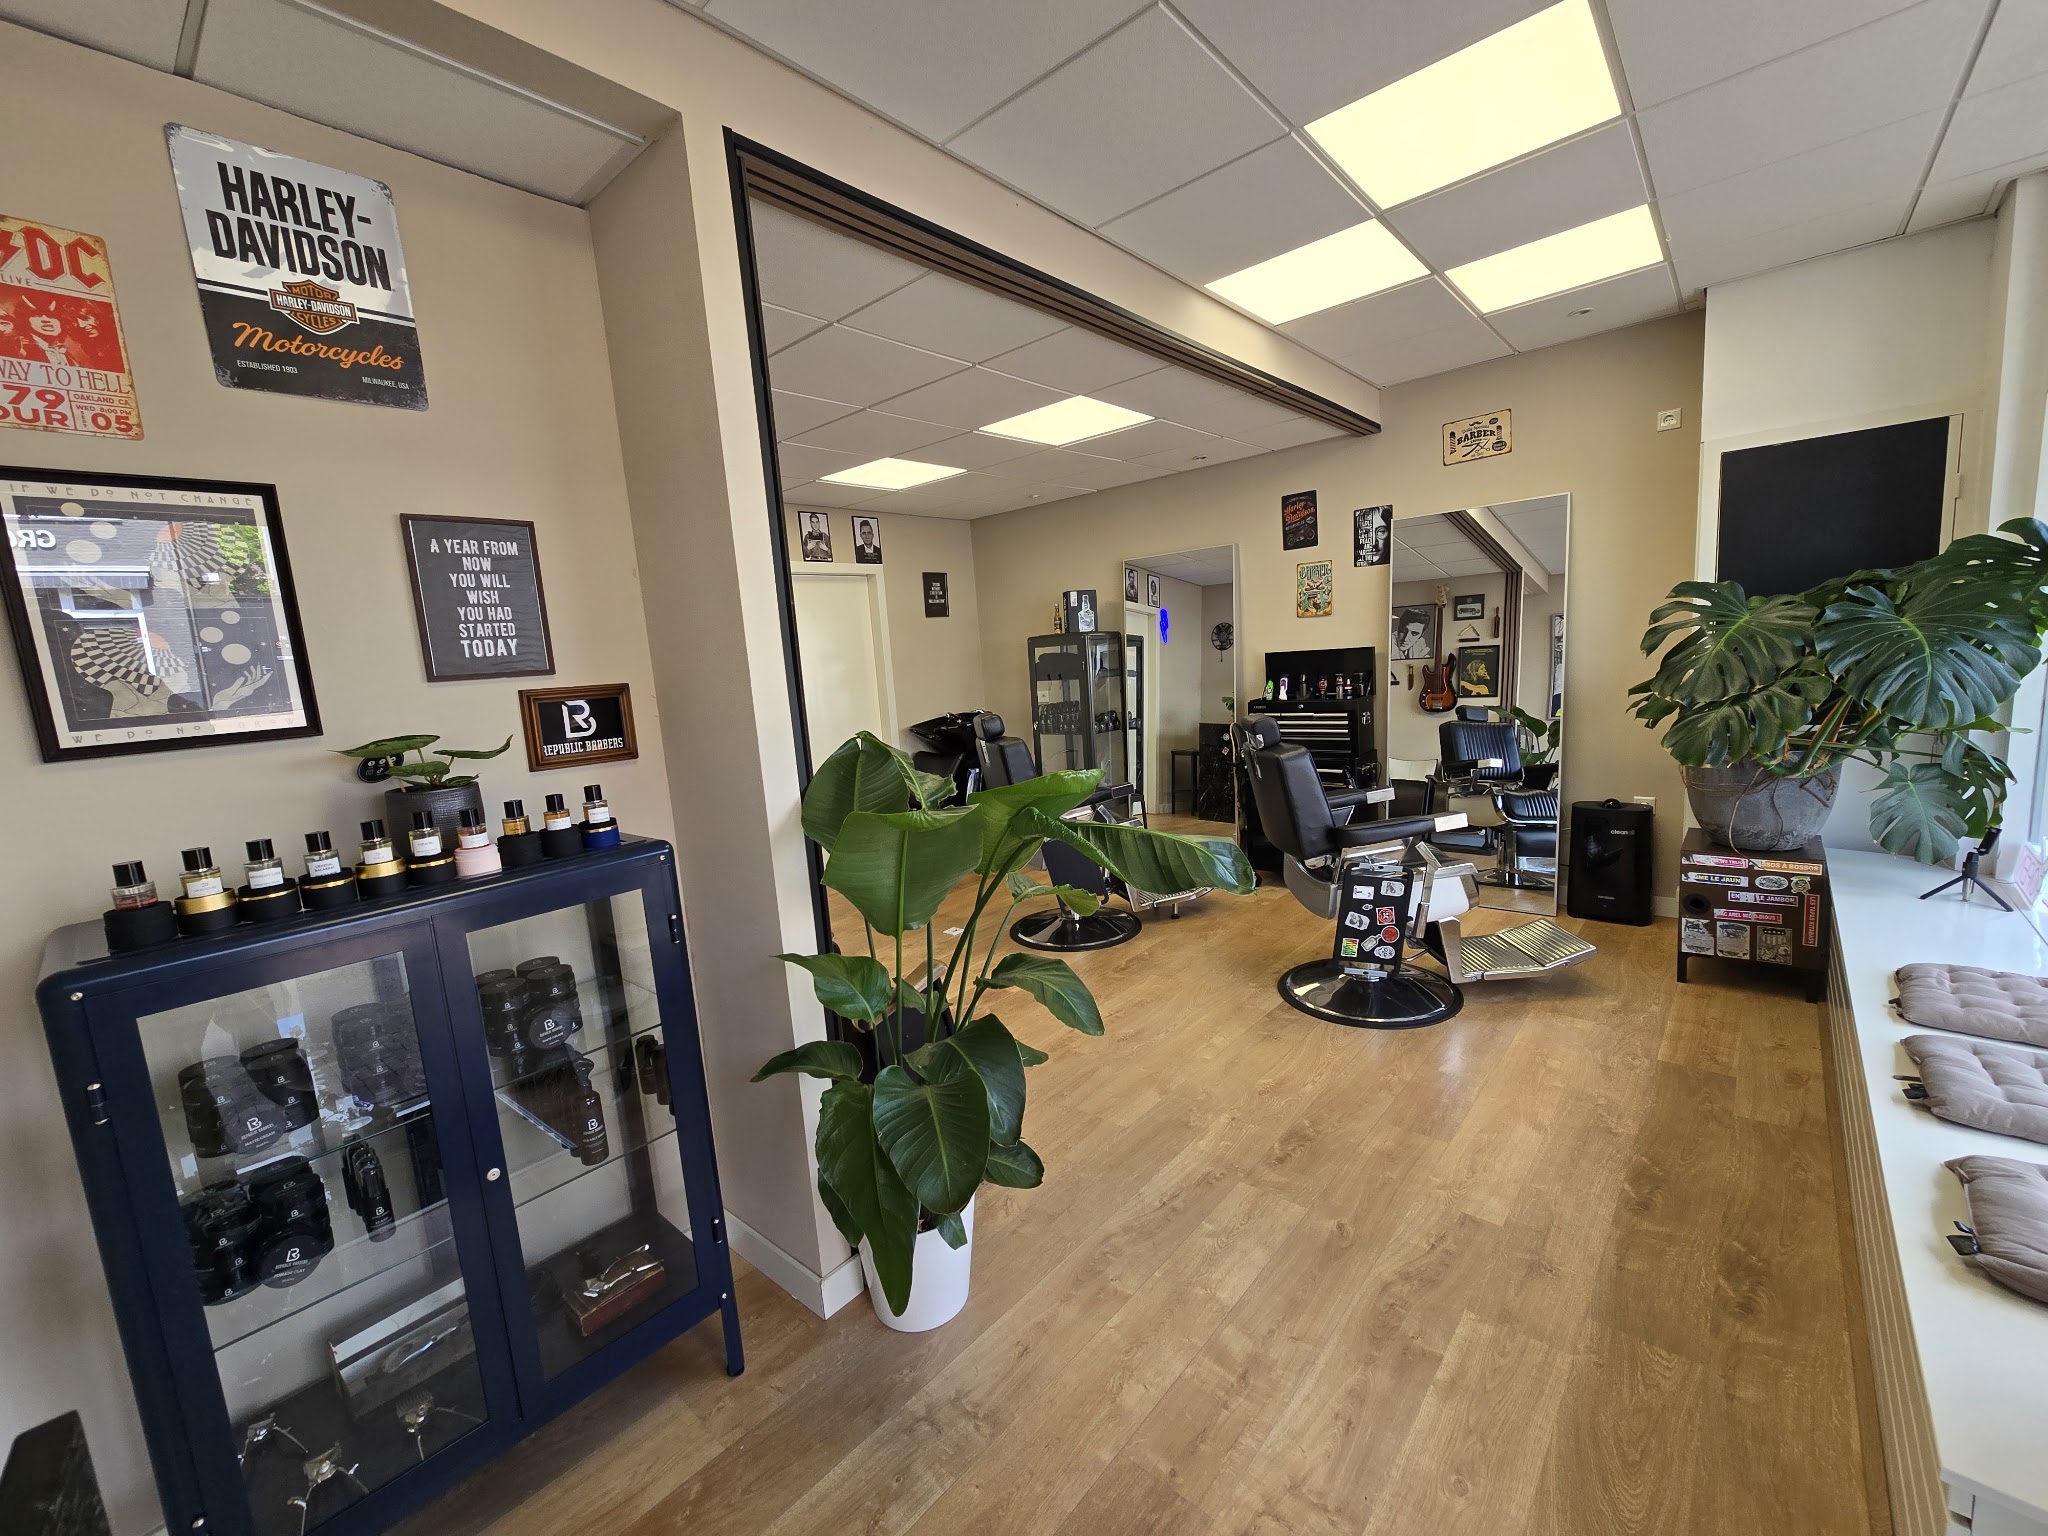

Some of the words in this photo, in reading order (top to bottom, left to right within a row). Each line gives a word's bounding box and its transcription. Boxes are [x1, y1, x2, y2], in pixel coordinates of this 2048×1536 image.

[216, 161, 372, 238] HARLEY-
[205, 208, 393, 292] DAVIDSON
[291, 285, 333, 299] MOTOR
[275, 293, 353, 318] HARLEY-DAVIDSON
[298, 311, 337, 329] CYCLES
[232, 322, 404, 370] Motorcycles
[236, 359, 281, 372] ESTABLISHED
[282, 365, 298, 374] 1903
[39, 364, 72, 387] TO
[76, 369, 131, 395] HELL
[73, 392, 115, 405] OAKLAND
[118, 397, 131, 406] CA
[75, 403, 96, 412] WED
[90, 412, 134, 433] 05
[1456, 429, 1497, 446] BARBER
[47, 486, 74, 496] WE
[430, 538, 440, 553] A
[443, 538, 480, 555] YEAR
[482, 540, 519, 556] FROM
[462, 556, 492, 572] NOW
[449, 573, 476, 588] YOU
[480, 574, 511, 588] WILL
[466, 590, 500, 605] WISH
[457, 606, 484, 621] YOU
[487, 606, 513, 621] HAD
[458, 622, 516, 638] STARTED
[460, 638, 518, 658] TODAY
[72, 734, 104, 744] WE
[585, 737, 624, 752] BARBERS
